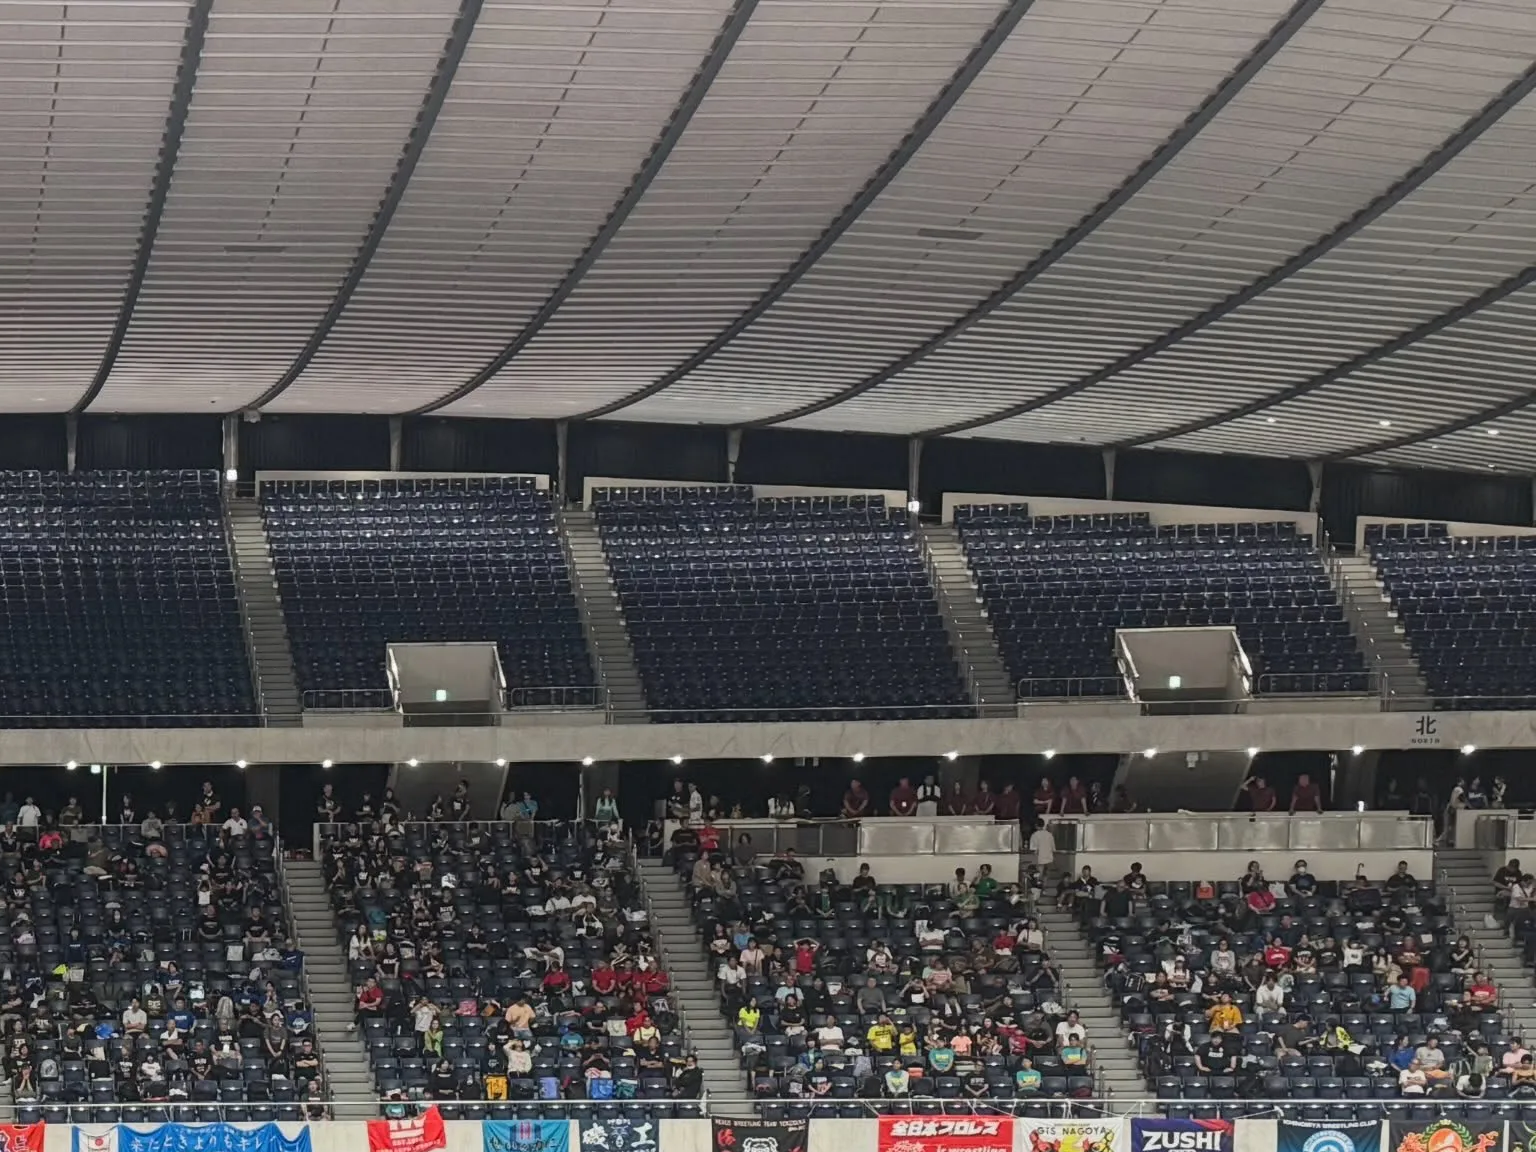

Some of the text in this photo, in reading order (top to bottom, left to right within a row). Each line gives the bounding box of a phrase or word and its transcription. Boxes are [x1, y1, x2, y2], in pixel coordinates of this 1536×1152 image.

[1416, 715, 1436, 735] 北
[890, 1120, 1001, 1137] 全日本プロレス
[1062, 1126, 1107, 1136] NAGOYA
[1141, 1130, 1225, 1151] ZUSHI
